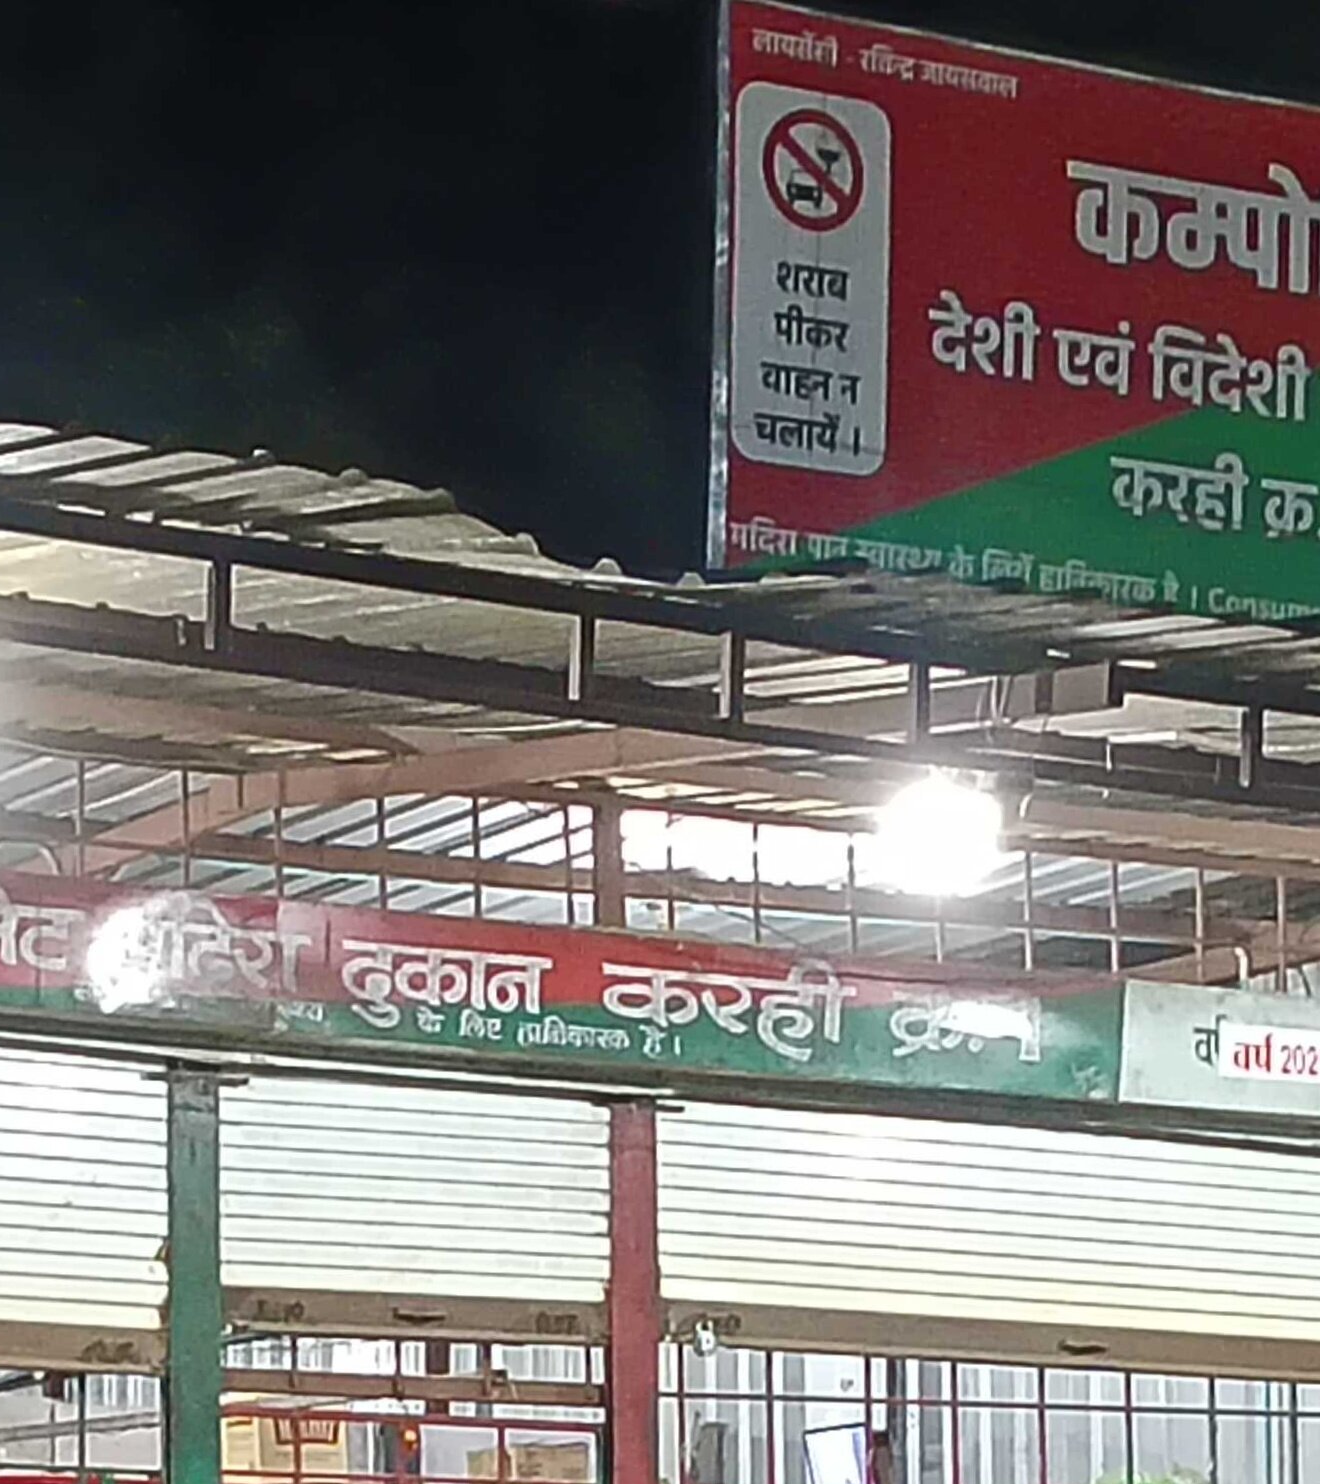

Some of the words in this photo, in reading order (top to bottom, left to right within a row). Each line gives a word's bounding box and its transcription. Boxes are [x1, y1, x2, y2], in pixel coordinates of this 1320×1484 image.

[920, 60, 1018, 98] जायसवाल
[776, 260, 848, 300] शराब
[774, 304, 849, 352] पीकर
[928, 289, 1041, 381] देशी
[1052, 320, 1135, 396] एवं
[1148, 323, 1312, 421] विदेशी
[761, 362, 833, 400] वाहन
[839, 374, 861, 405] न
[1110, 452, 1249, 532] करही
[730, 515, 797, 556] मदिरा
[949, 544, 975, 579] के
[342, 939, 552, 1029] दुकान
[602, 958, 858, 1063] करही
[1233, 1033, 1272, 1074] वर्ष
